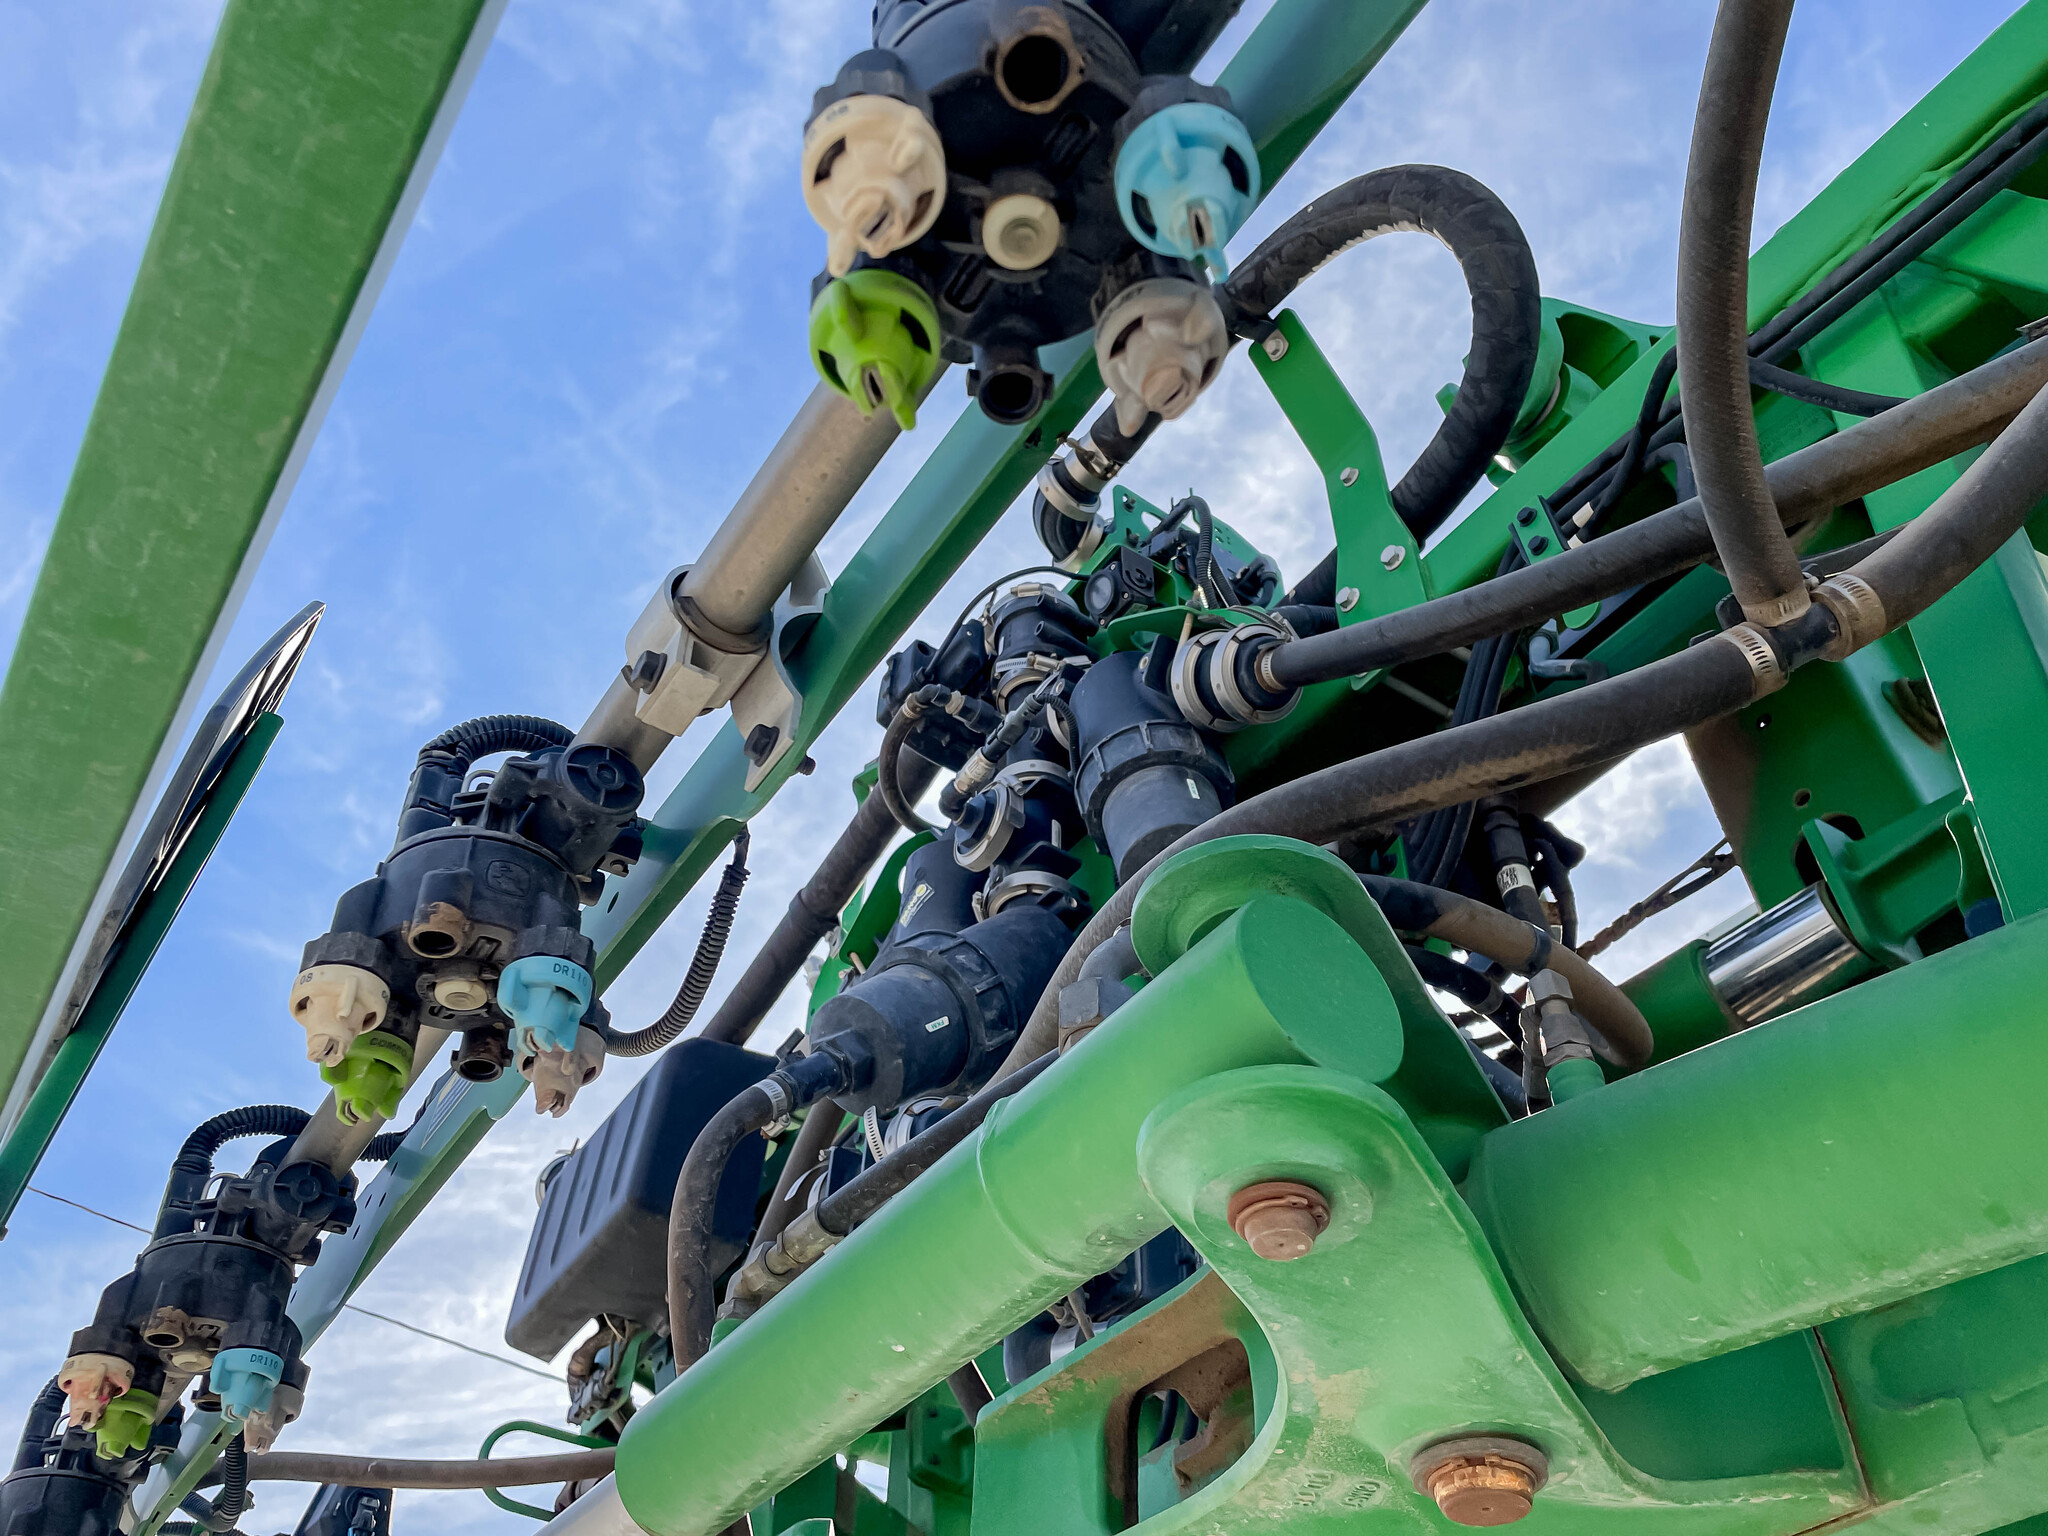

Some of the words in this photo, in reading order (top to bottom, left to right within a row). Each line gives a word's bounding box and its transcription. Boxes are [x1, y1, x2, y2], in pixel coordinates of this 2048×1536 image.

[300, 972, 313, 985] 08
[553, 963, 589, 987] DR110
[250, 1353, 279, 1370] DR110
